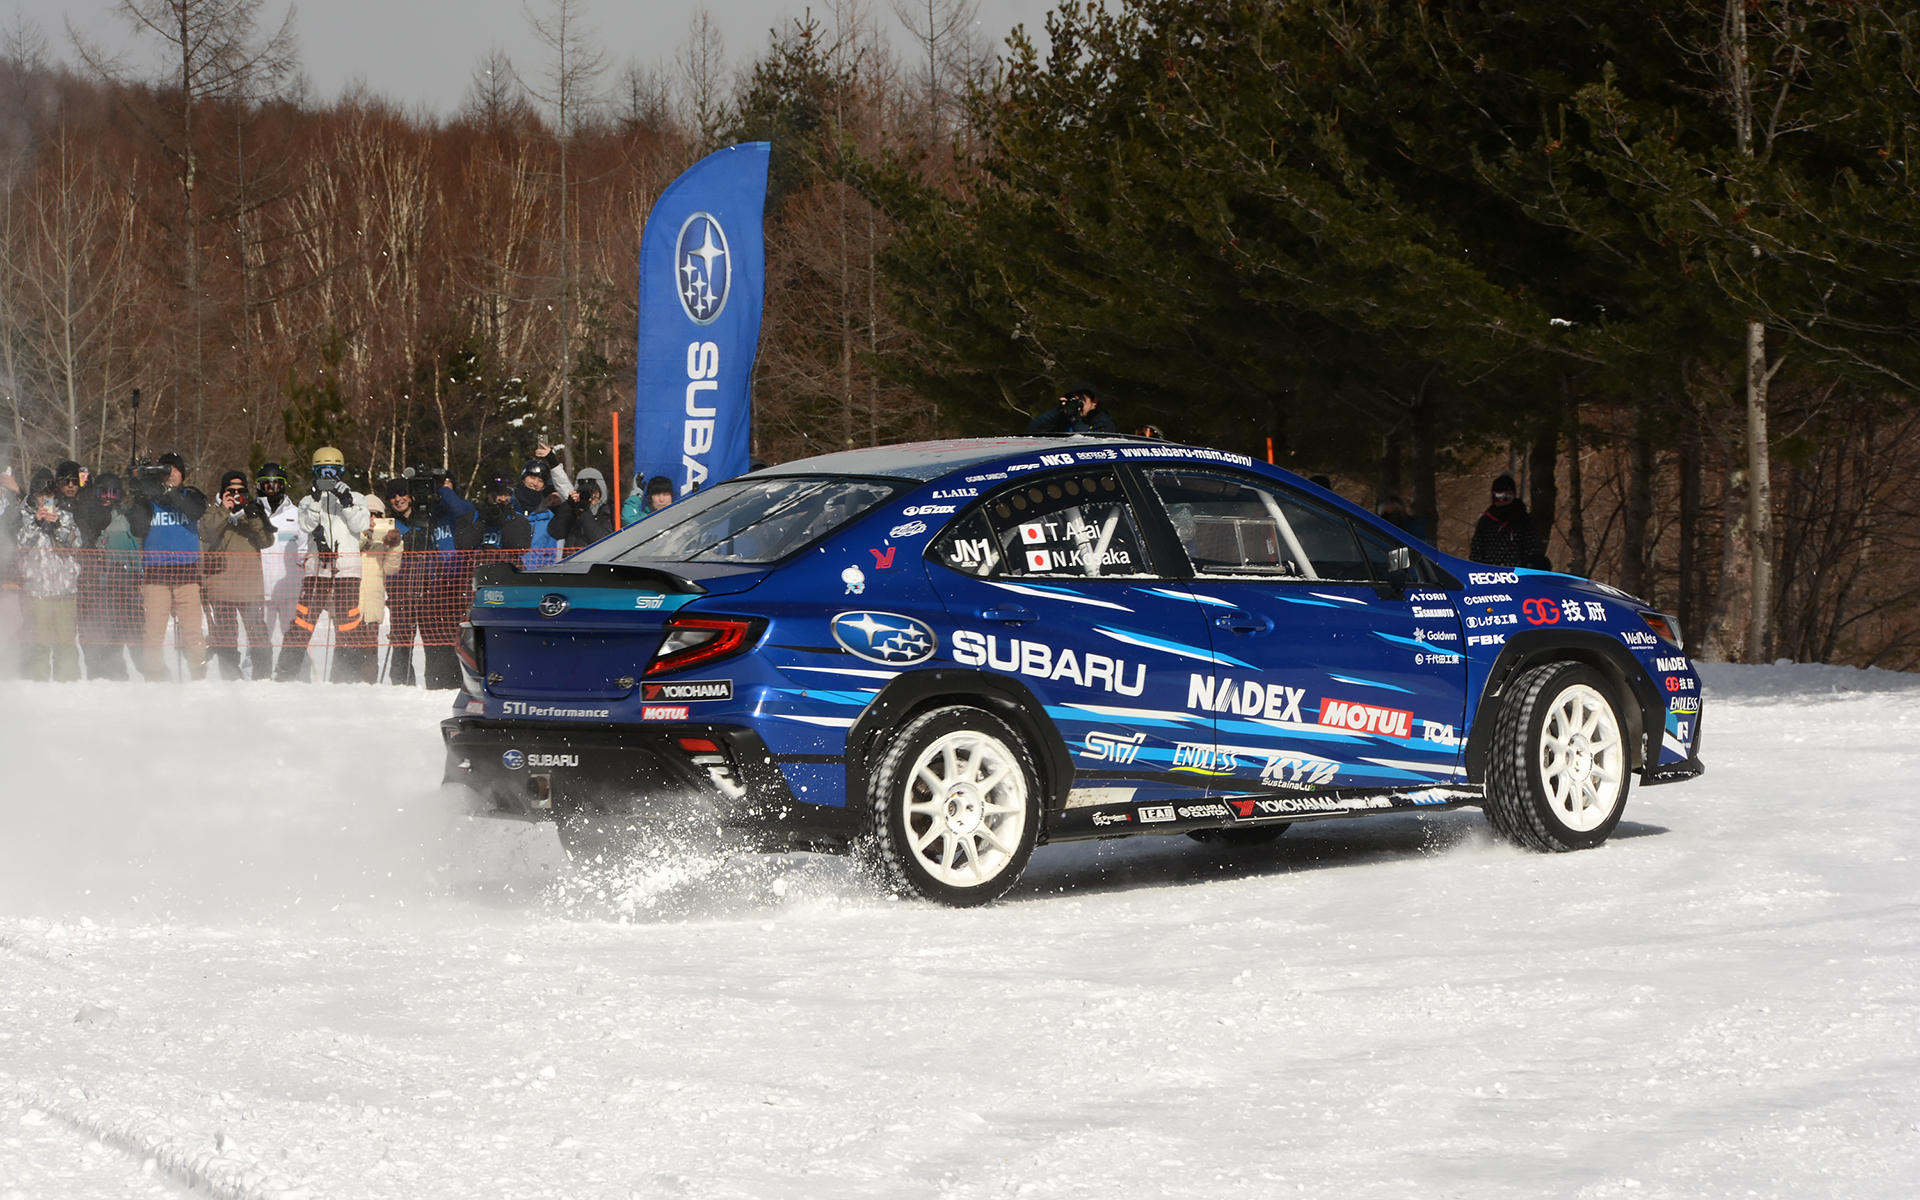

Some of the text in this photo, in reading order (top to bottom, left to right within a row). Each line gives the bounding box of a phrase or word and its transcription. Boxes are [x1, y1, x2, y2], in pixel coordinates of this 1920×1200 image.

[680, 341, 719, 497] SUBA
[1039, 453, 1075, 467] NKB
[1120, 446, 1252, 467] www.subaru-msm.com/
[942, 488, 979, 498] LAILE
[150, 511, 189, 526] MEDIA
[483, 532, 501, 546] EDI
[950, 538, 993, 566] JN1
[1052, 548, 1131, 567] N.Kosaka
[1468, 572, 1519, 585] RECARO
[1471, 594, 1512, 604] CHIYODA
[1427, 630, 1457, 641] Goldwin
[1467, 633, 1506, 646] FBK
[952, 629, 1147, 697] SUBARU
[1425, 654, 1460, 665] 千代田工業
[662, 684, 729, 698] YOKOHAMA
[1186, 672, 1306, 723] NADEX
[503, 701, 610, 718] STI Performance
[1670, 696, 1699, 711] ENDLESS
[643, 707, 688, 720] MOTUL
[1321, 700, 1409, 737] MOTUL
[527, 754, 579, 767] SUBARU
[1172, 743, 1240, 772] ENDLESS
[1259, 755, 1341, 785] KYB
[1261, 777, 1316, 792] SustainaLub
[1191, 809, 1230, 817] CLUTCH
[1256, 797, 1340, 814] YOKOHAMA
